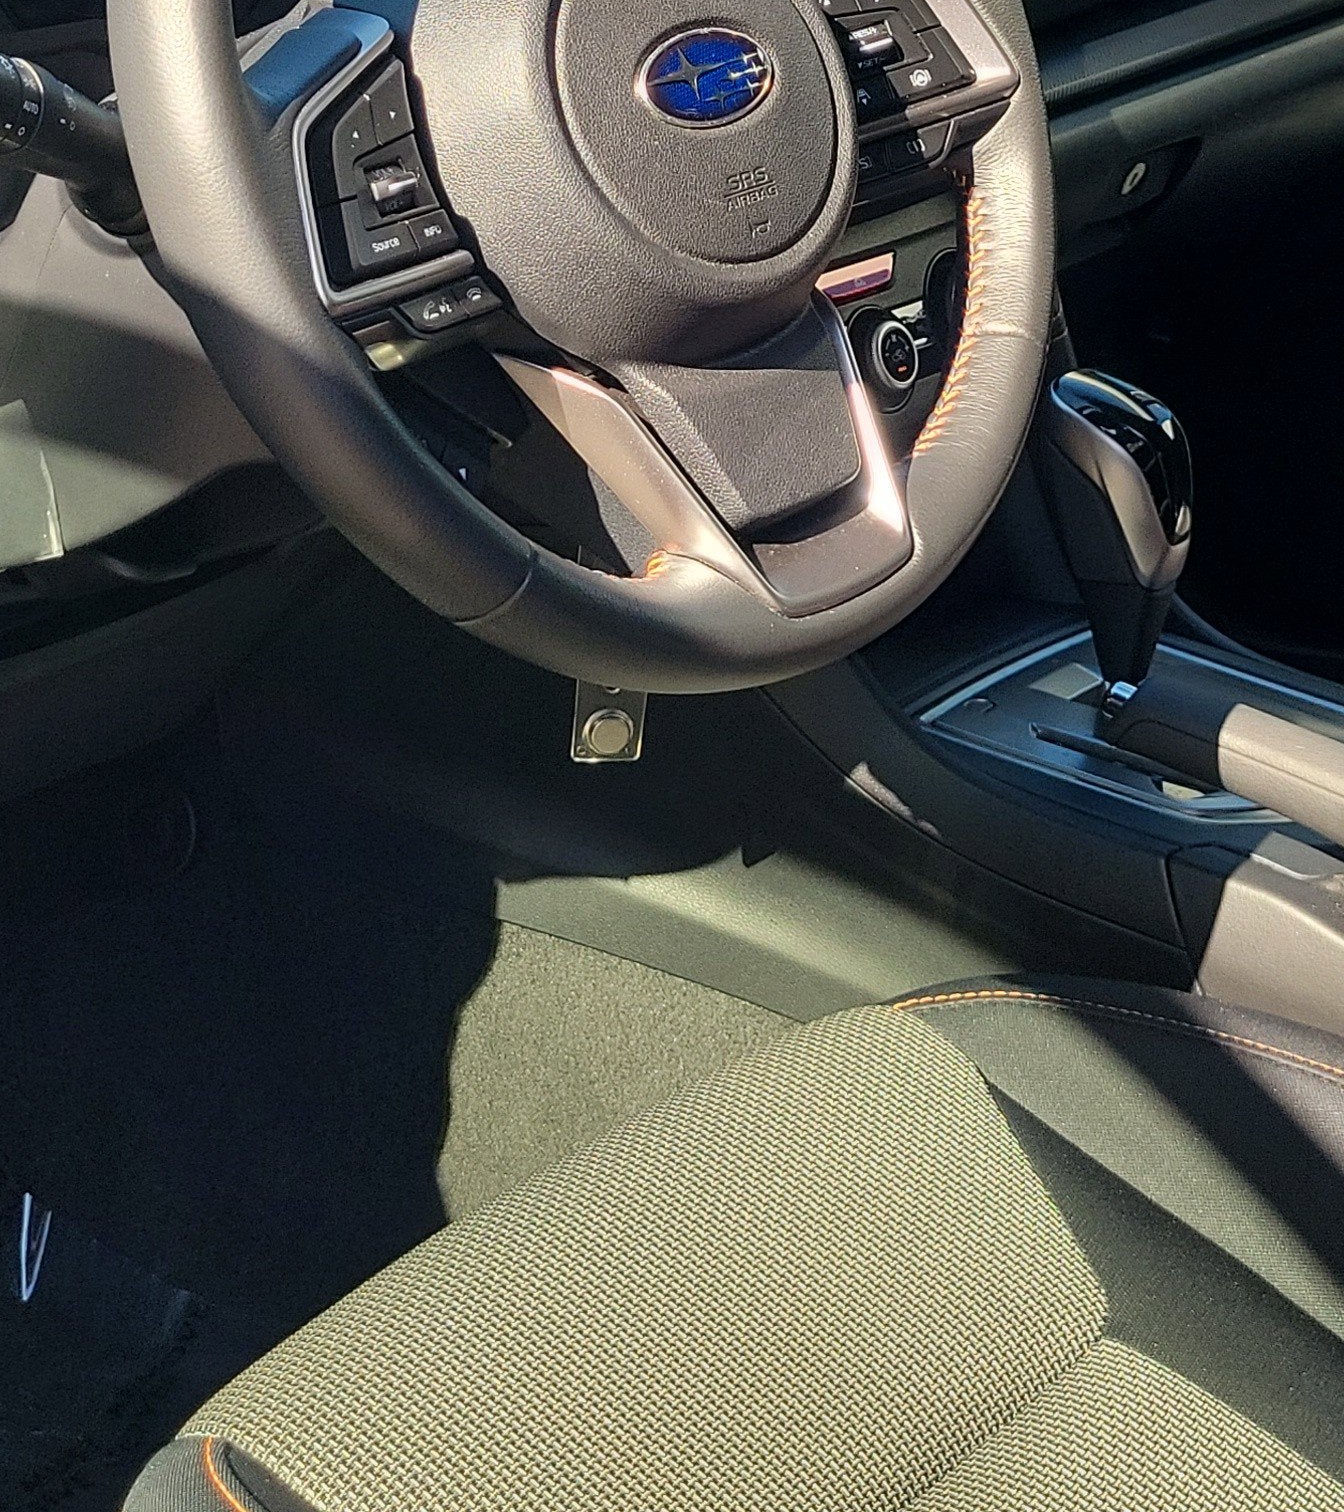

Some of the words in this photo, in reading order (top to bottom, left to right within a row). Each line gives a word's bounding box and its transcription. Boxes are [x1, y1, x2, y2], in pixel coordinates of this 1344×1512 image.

[726, 167, 769, 191] SRS
[727, 185, 779, 212] AIRBAG
[423, 225, 443, 238] INFO
[371, 237, 401, 253] Source
